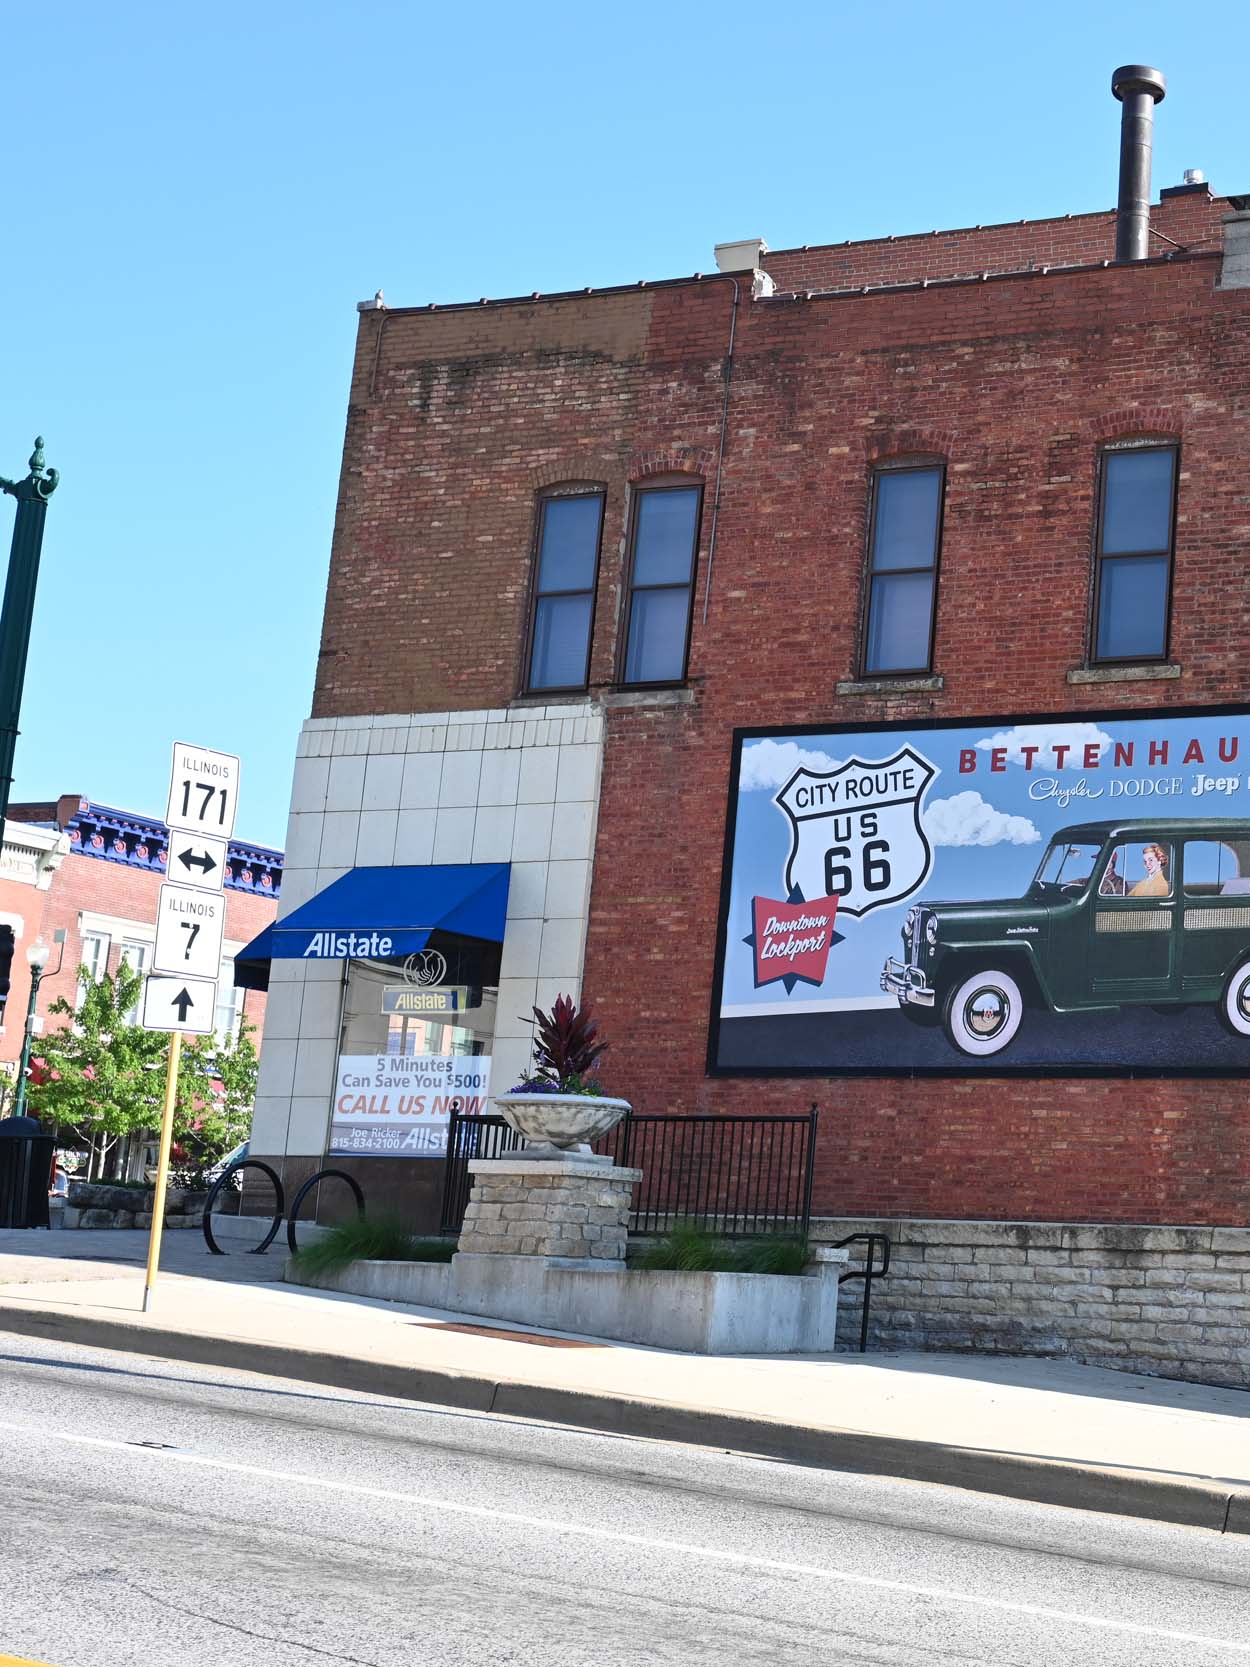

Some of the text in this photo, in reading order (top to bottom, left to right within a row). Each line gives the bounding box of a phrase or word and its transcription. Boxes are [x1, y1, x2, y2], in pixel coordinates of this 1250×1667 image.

[183, 757, 229, 778] ILLINOIS
[795, 768, 915, 808] CITY ROUTE
[1028, 777, 1104, 808] Chrysler
[1109, 777, 1183, 797] DODGE
[1191, 774, 1240, 797] Jeep
[182, 780, 227, 825] 171
[834, 812, 878, 842] US
[824, 839, 891, 897] 66
[169, 898, 215, 918] ILLINOIS
[763, 914, 829, 937] Downtown
[180, 922, 201, 960] 7
[303, 932, 393, 957] Allstate
[761, 930, 826, 961] Lockport
[394, 993, 446, 1009] Allstate
[376, 1057, 453, 1072] 5 Minutes
[342, 1073, 487, 1089] Can Save You $500!
[337, 1094, 487, 1115] CALL US NOW
[332, 1138, 400, 1149] 815-834-2100
[350, 1127, 401, 1138] Joe Ricker
